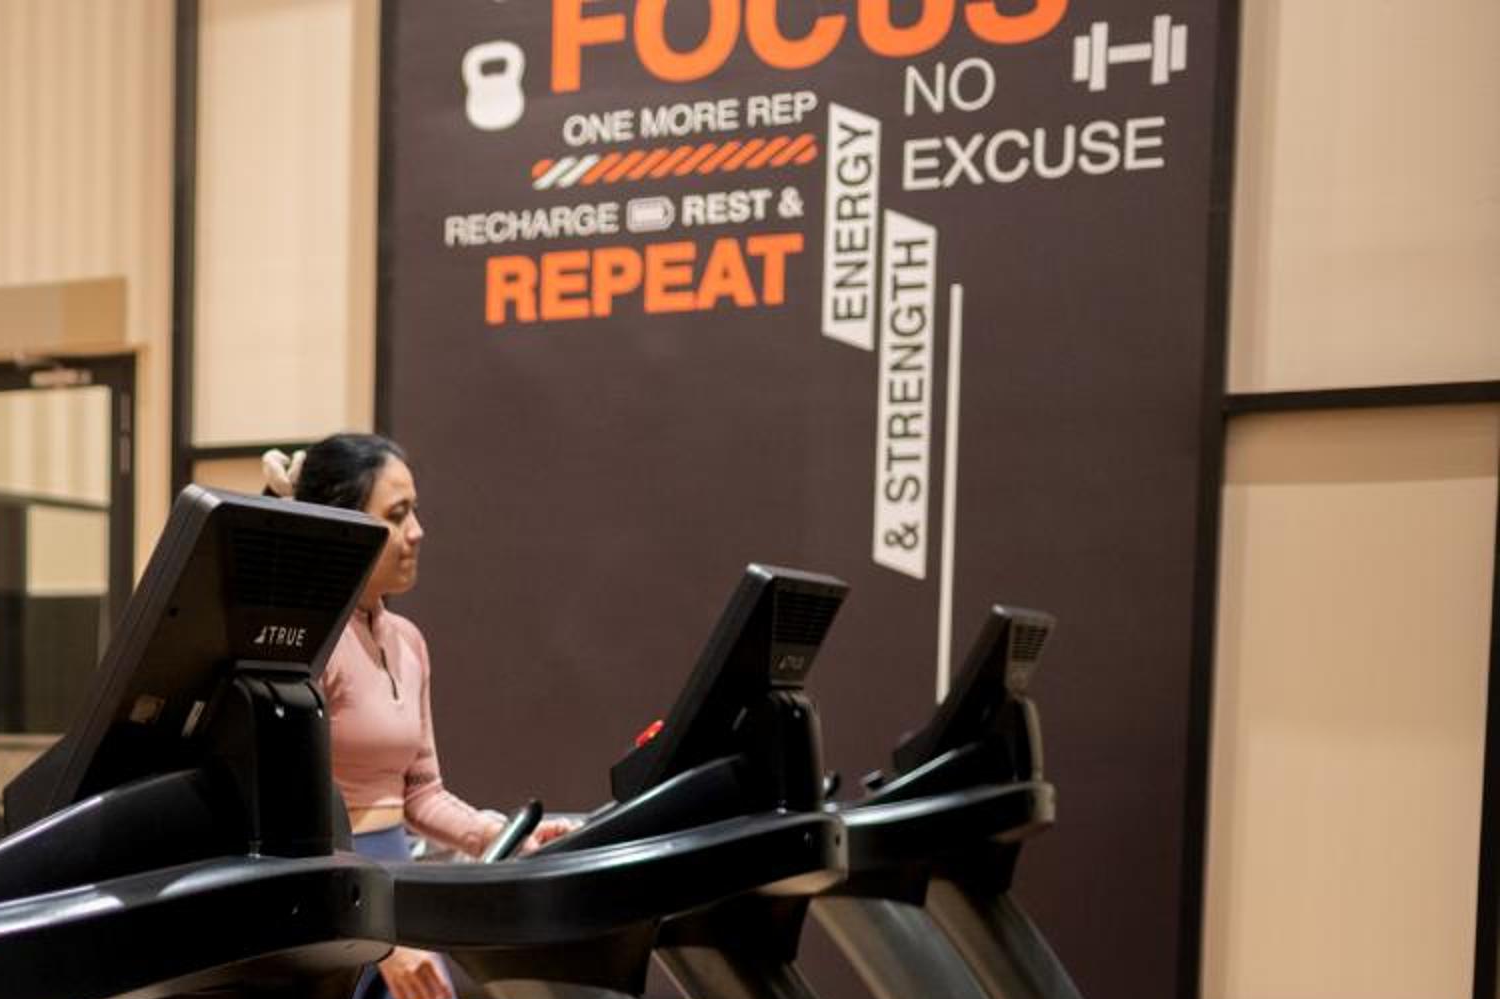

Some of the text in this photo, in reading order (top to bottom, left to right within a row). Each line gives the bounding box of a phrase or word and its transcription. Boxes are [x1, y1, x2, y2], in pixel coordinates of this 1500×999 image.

[563, 91, 818, 146] ONE MORE REP
[904, 58, 996, 117] NO
[903, 116, 1166, 191] EXCUSE
[445, 187, 804, 246] RECHARGE REST &
[833, 121, 874, 322] ENERGY
[485, 232, 804, 326] REPEAT
[884, 237, 930, 551] & STRENGTH
[268, 626, 307, 647] TRUE
